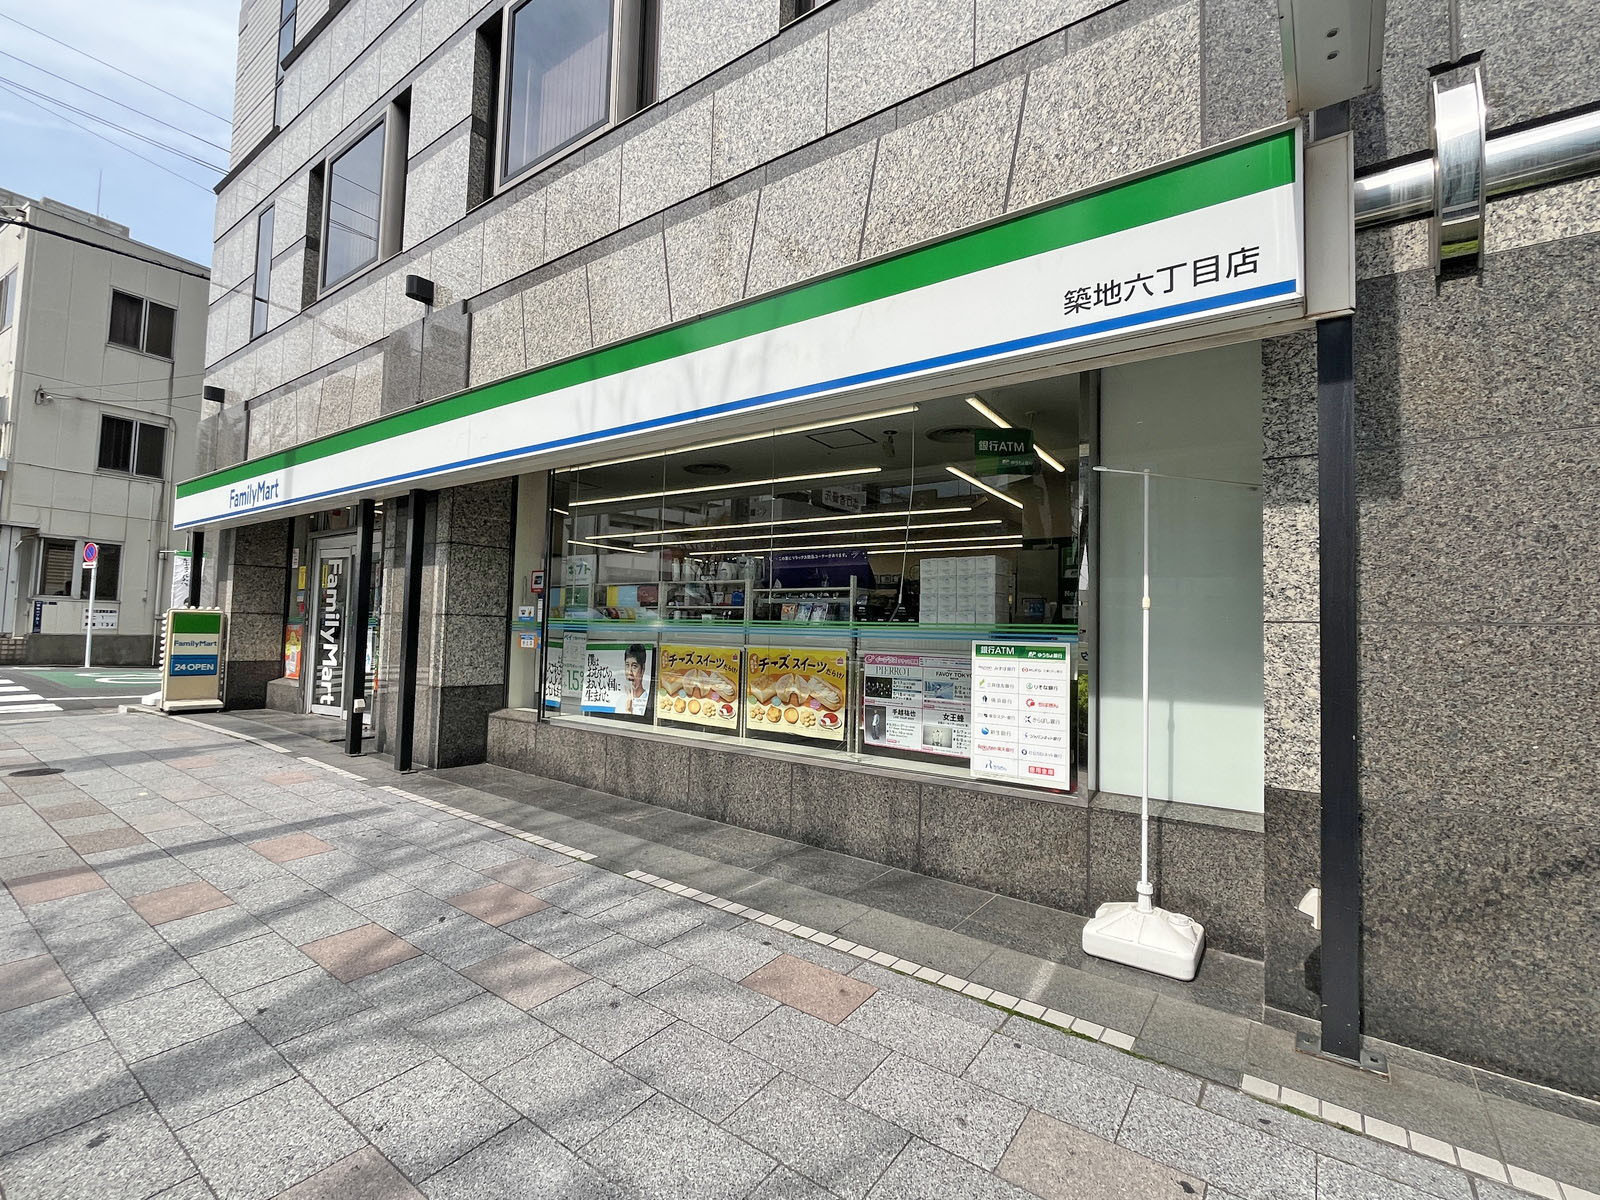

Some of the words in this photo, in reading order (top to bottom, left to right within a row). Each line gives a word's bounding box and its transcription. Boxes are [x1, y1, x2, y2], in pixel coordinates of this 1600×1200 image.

[1063, 246, 1260, 316] 築地六丁目店
[978, 441, 1025, 453] 銀行ATM
[229, 479, 279, 509] FamilyMart
[319, 559, 344, 706] FamilyMart
[173, 640, 218, 648] FamilyMart
[980, 646, 1015, 655] 銀行ATM
[174, 663, 187, 671] 24
[187, 663, 215, 671] OPEN
[876, 665, 911, 677] PIERROT
[942, 713, 965, 723] 女王蜂
